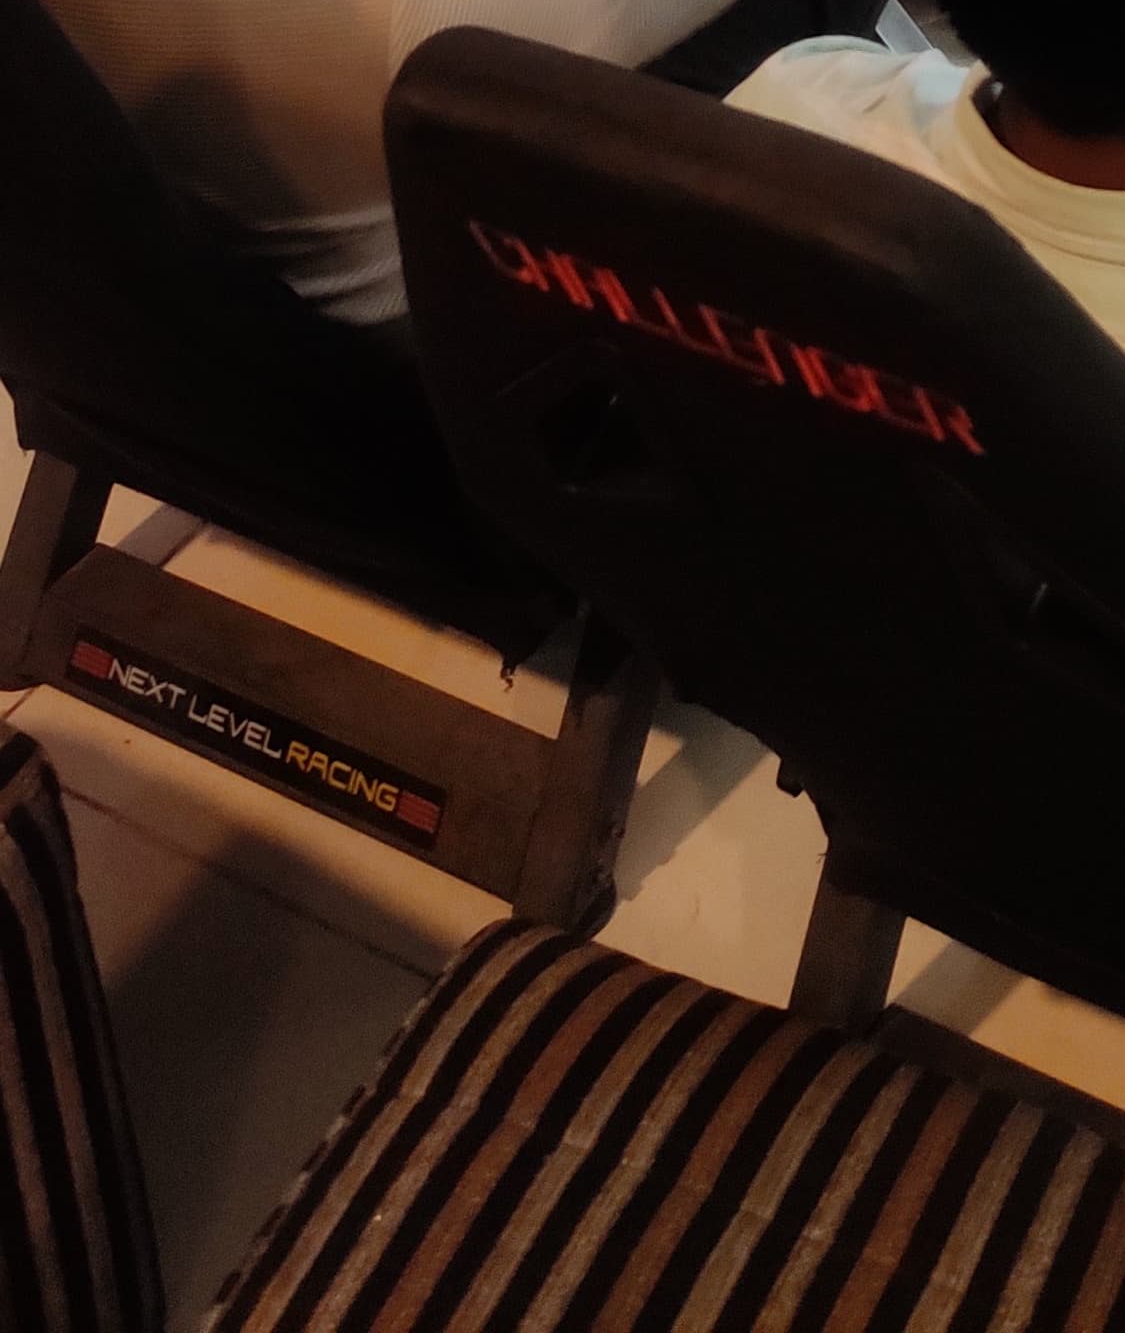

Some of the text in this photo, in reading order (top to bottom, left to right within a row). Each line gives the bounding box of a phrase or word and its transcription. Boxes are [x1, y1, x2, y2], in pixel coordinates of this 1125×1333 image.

[108, 658, 399, 813] NEXT LEVEL RACING
